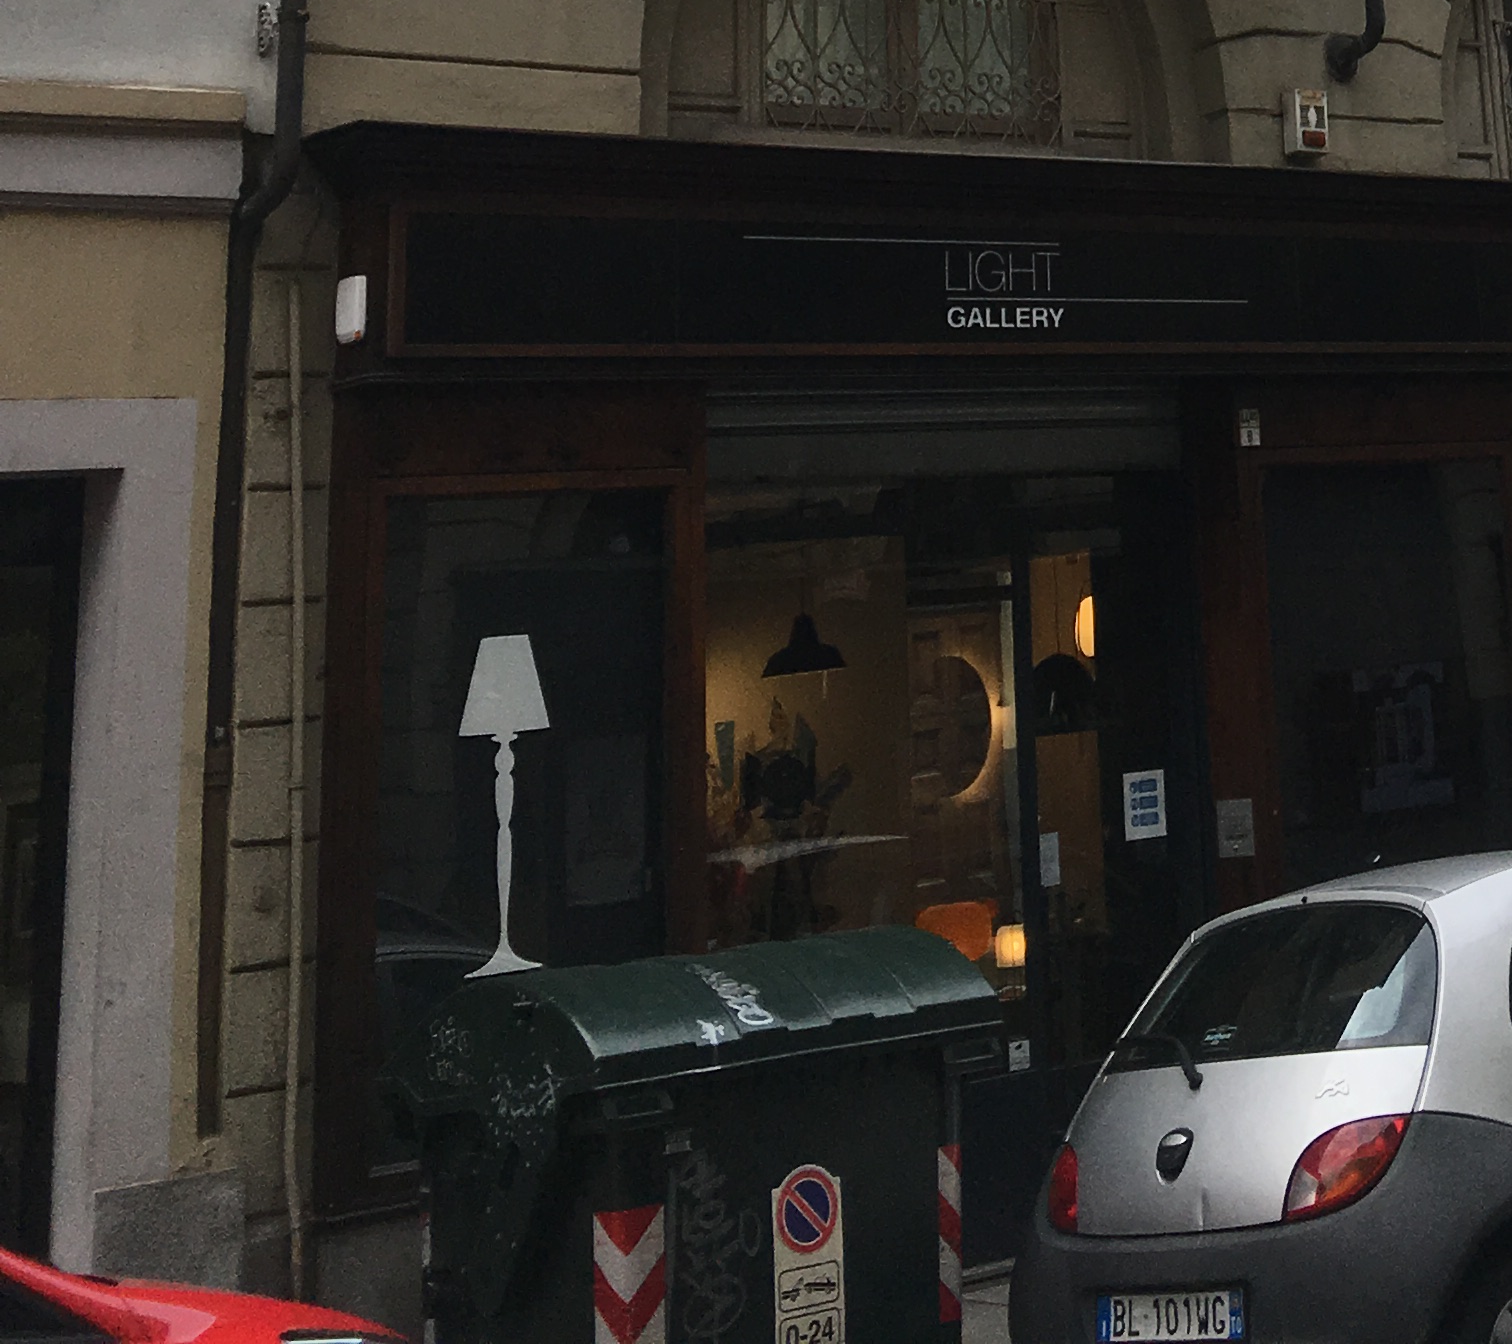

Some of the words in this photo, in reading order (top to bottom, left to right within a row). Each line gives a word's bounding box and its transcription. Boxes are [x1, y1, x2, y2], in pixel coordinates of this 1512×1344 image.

[945, 250, 1060, 292] LIGHT
[947, 306, 1064, 328] GALLERY
[785, 1316, 835, 1344] 0-24
[1112, 1298, 1140, 1338] BL
